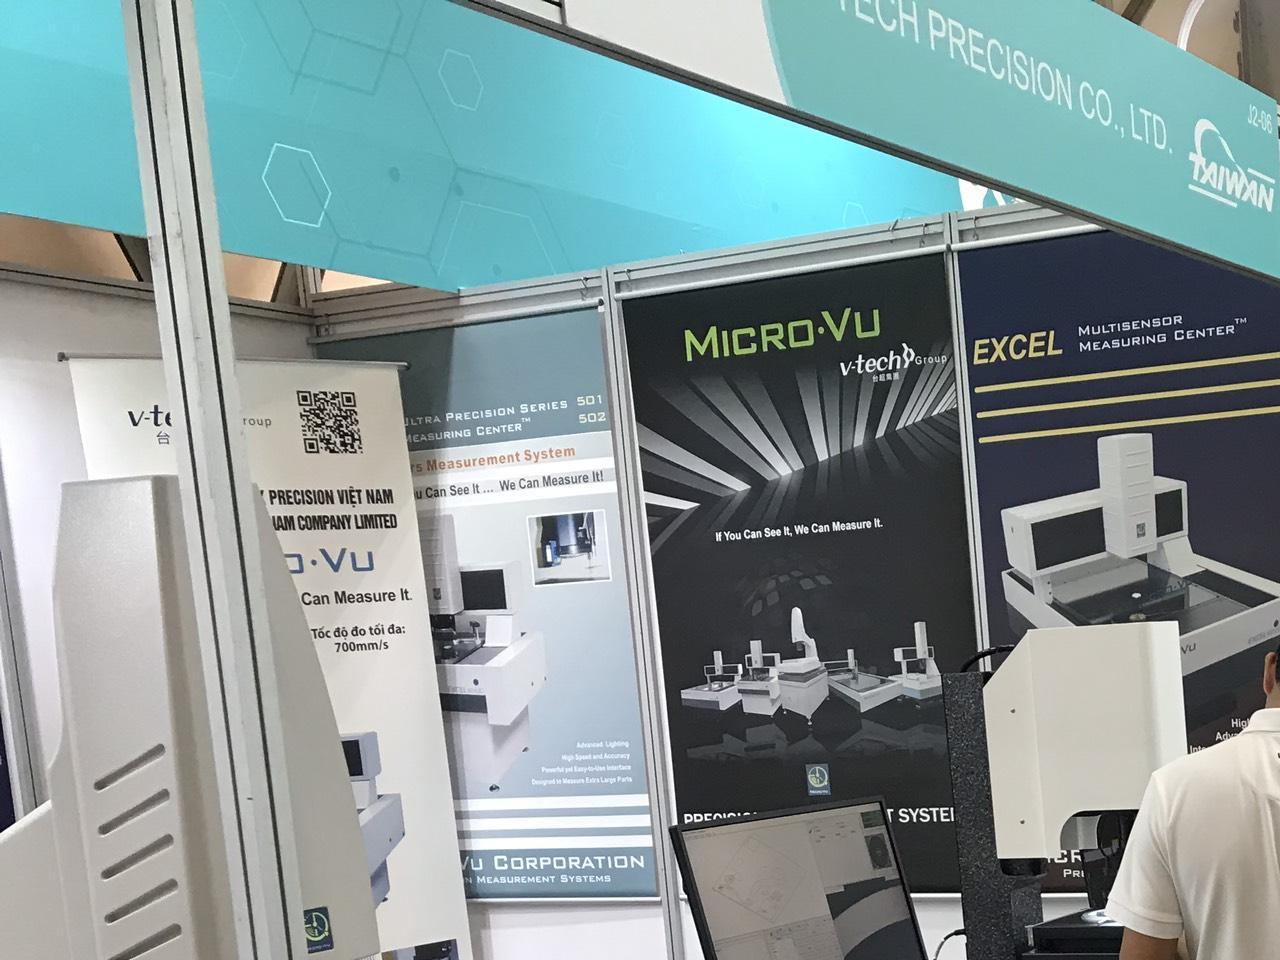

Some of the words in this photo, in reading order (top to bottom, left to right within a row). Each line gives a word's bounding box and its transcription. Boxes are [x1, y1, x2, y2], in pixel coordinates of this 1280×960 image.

[840, 0, 919, 43] ECH
[928, 9, 1072, 111] PRECISION
[1079, 81, 1125, 138] CO.,
[1130, 103, 1173, 154] LTD.
[1188, 149, 1275, 212] TAIWAN
[1077, 315, 1183, 337] MULTISENSOR
[972, 329, 1064, 366] EXCEL
[1079, 333, 1167, 353] MEASURING
[840, 350, 901, 376] v-tech
[915, 355, 947, 366] Group
[446, 406, 515, 422] PRECISION
[519, 399, 568, 414] SERIES
[577, 394, 603, 406] 501
[578, 411, 607, 424] 502
[242, 415, 272, 428] roup
[426, 451, 521, 472] Measurement
[524, 446, 576, 462] System
[425, 486, 447, 499] Can
[449, 484, 470, 496] See
[472, 483, 480, 494] It
[499, 478, 516, 491] We
[518, 476, 540, 489] Can
[542, 472, 589, 487] Measure
[592, 469, 604, 482] It!
[269, 489, 334, 505] PRECISION
[336, 485, 364, 508] VIỆT
[365, 488, 394, 504] NAM
[298, 514, 352, 531] COMPANY
[354, 513, 397, 529] LIMITED
[715, 532, 722, 542] If
[723, 530, 741, 540] You
[743, 528, 762, 539] Can
[764, 527, 782, 538] See
[783, 526, 793, 537] It,
[793, 524, 809, 535] We
[811, 523, 830, 533] Can
[832, 519, 872, 532] Measure
[873, 517, 883, 528] It.
[301, 591, 330, 606] Can
[334, 589, 397, 605] Measure
[400, 588, 413, 601] It.
[311, 626, 331, 640] Tốc
[333, 625, 349, 639] độ
[351, 625, 366, 638] đo
[369, 624, 385, 637] tối
[387, 623, 406, 636] đa:
[334, 641, 389, 653] 700mm/s
[493, 855, 645, 870] CORPORATION
[476, 875, 556, 884] MEASUREMENT
[560, 874, 612, 883] SYSTEMS
